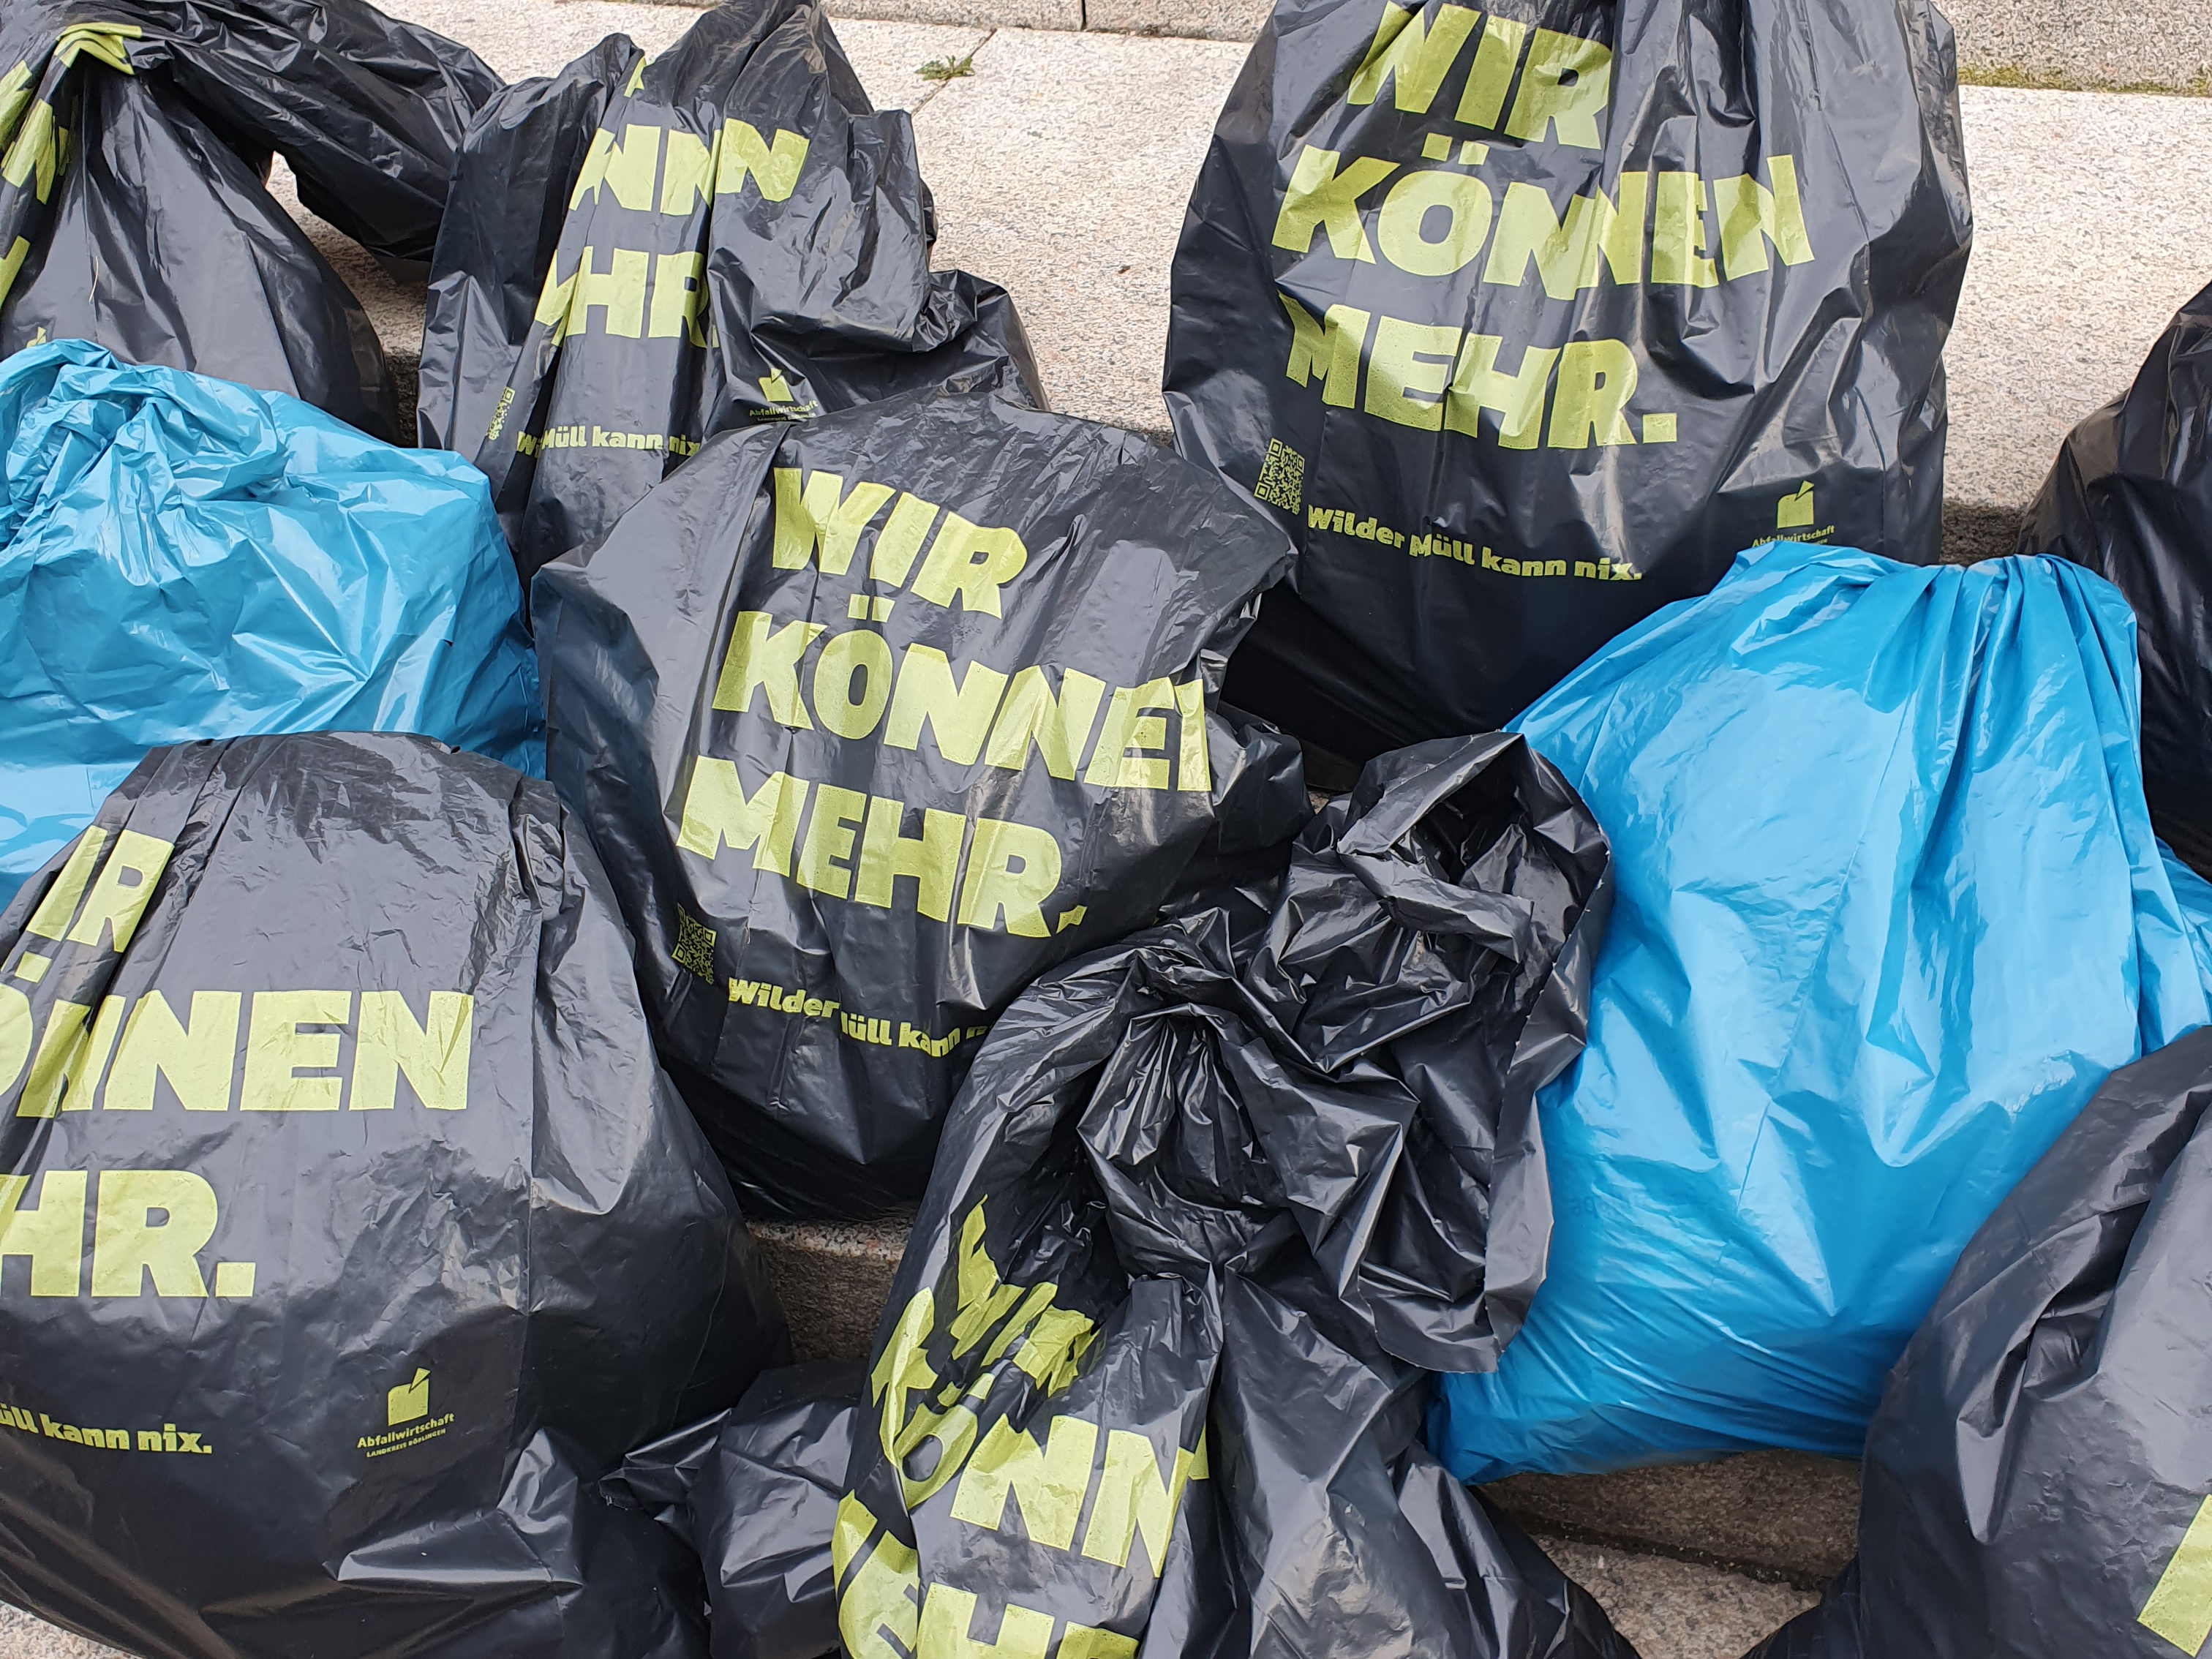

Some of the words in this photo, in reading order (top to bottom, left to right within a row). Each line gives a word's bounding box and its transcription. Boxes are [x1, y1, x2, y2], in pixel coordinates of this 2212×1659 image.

[1271, 134, 1815, 301] KÖNNEN
[1278, 290, 1677, 450] MEHR.
[592, 426, 663, 449] kann
[669, 434, 700, 457] nix
[772, 467, 1028, 619] WIR
[1308, 504, 1404, 549] Wilder
[1409, 534, 1475, 565] Müll
[1481, 546, 1566, 577] kann
[1574, 557, 1643, 581] nix.
[26, 826, 174, 953] IR
[676, 755, 1087, 938] MEHR.
[728, 977, 840, 1017] Wilder
[840, 1011, 892, 1046] üll
[898, 1022, 960, 1058] kann
[0, 1170, 257, 1298] HR.
[0, 1402, 39, 1434] üll
[40, 1413, 130, 1451] kann
[138, 1423, 212, 1454] nix.
[357, 1413, 454, 1448] Abfallwirtschaft
